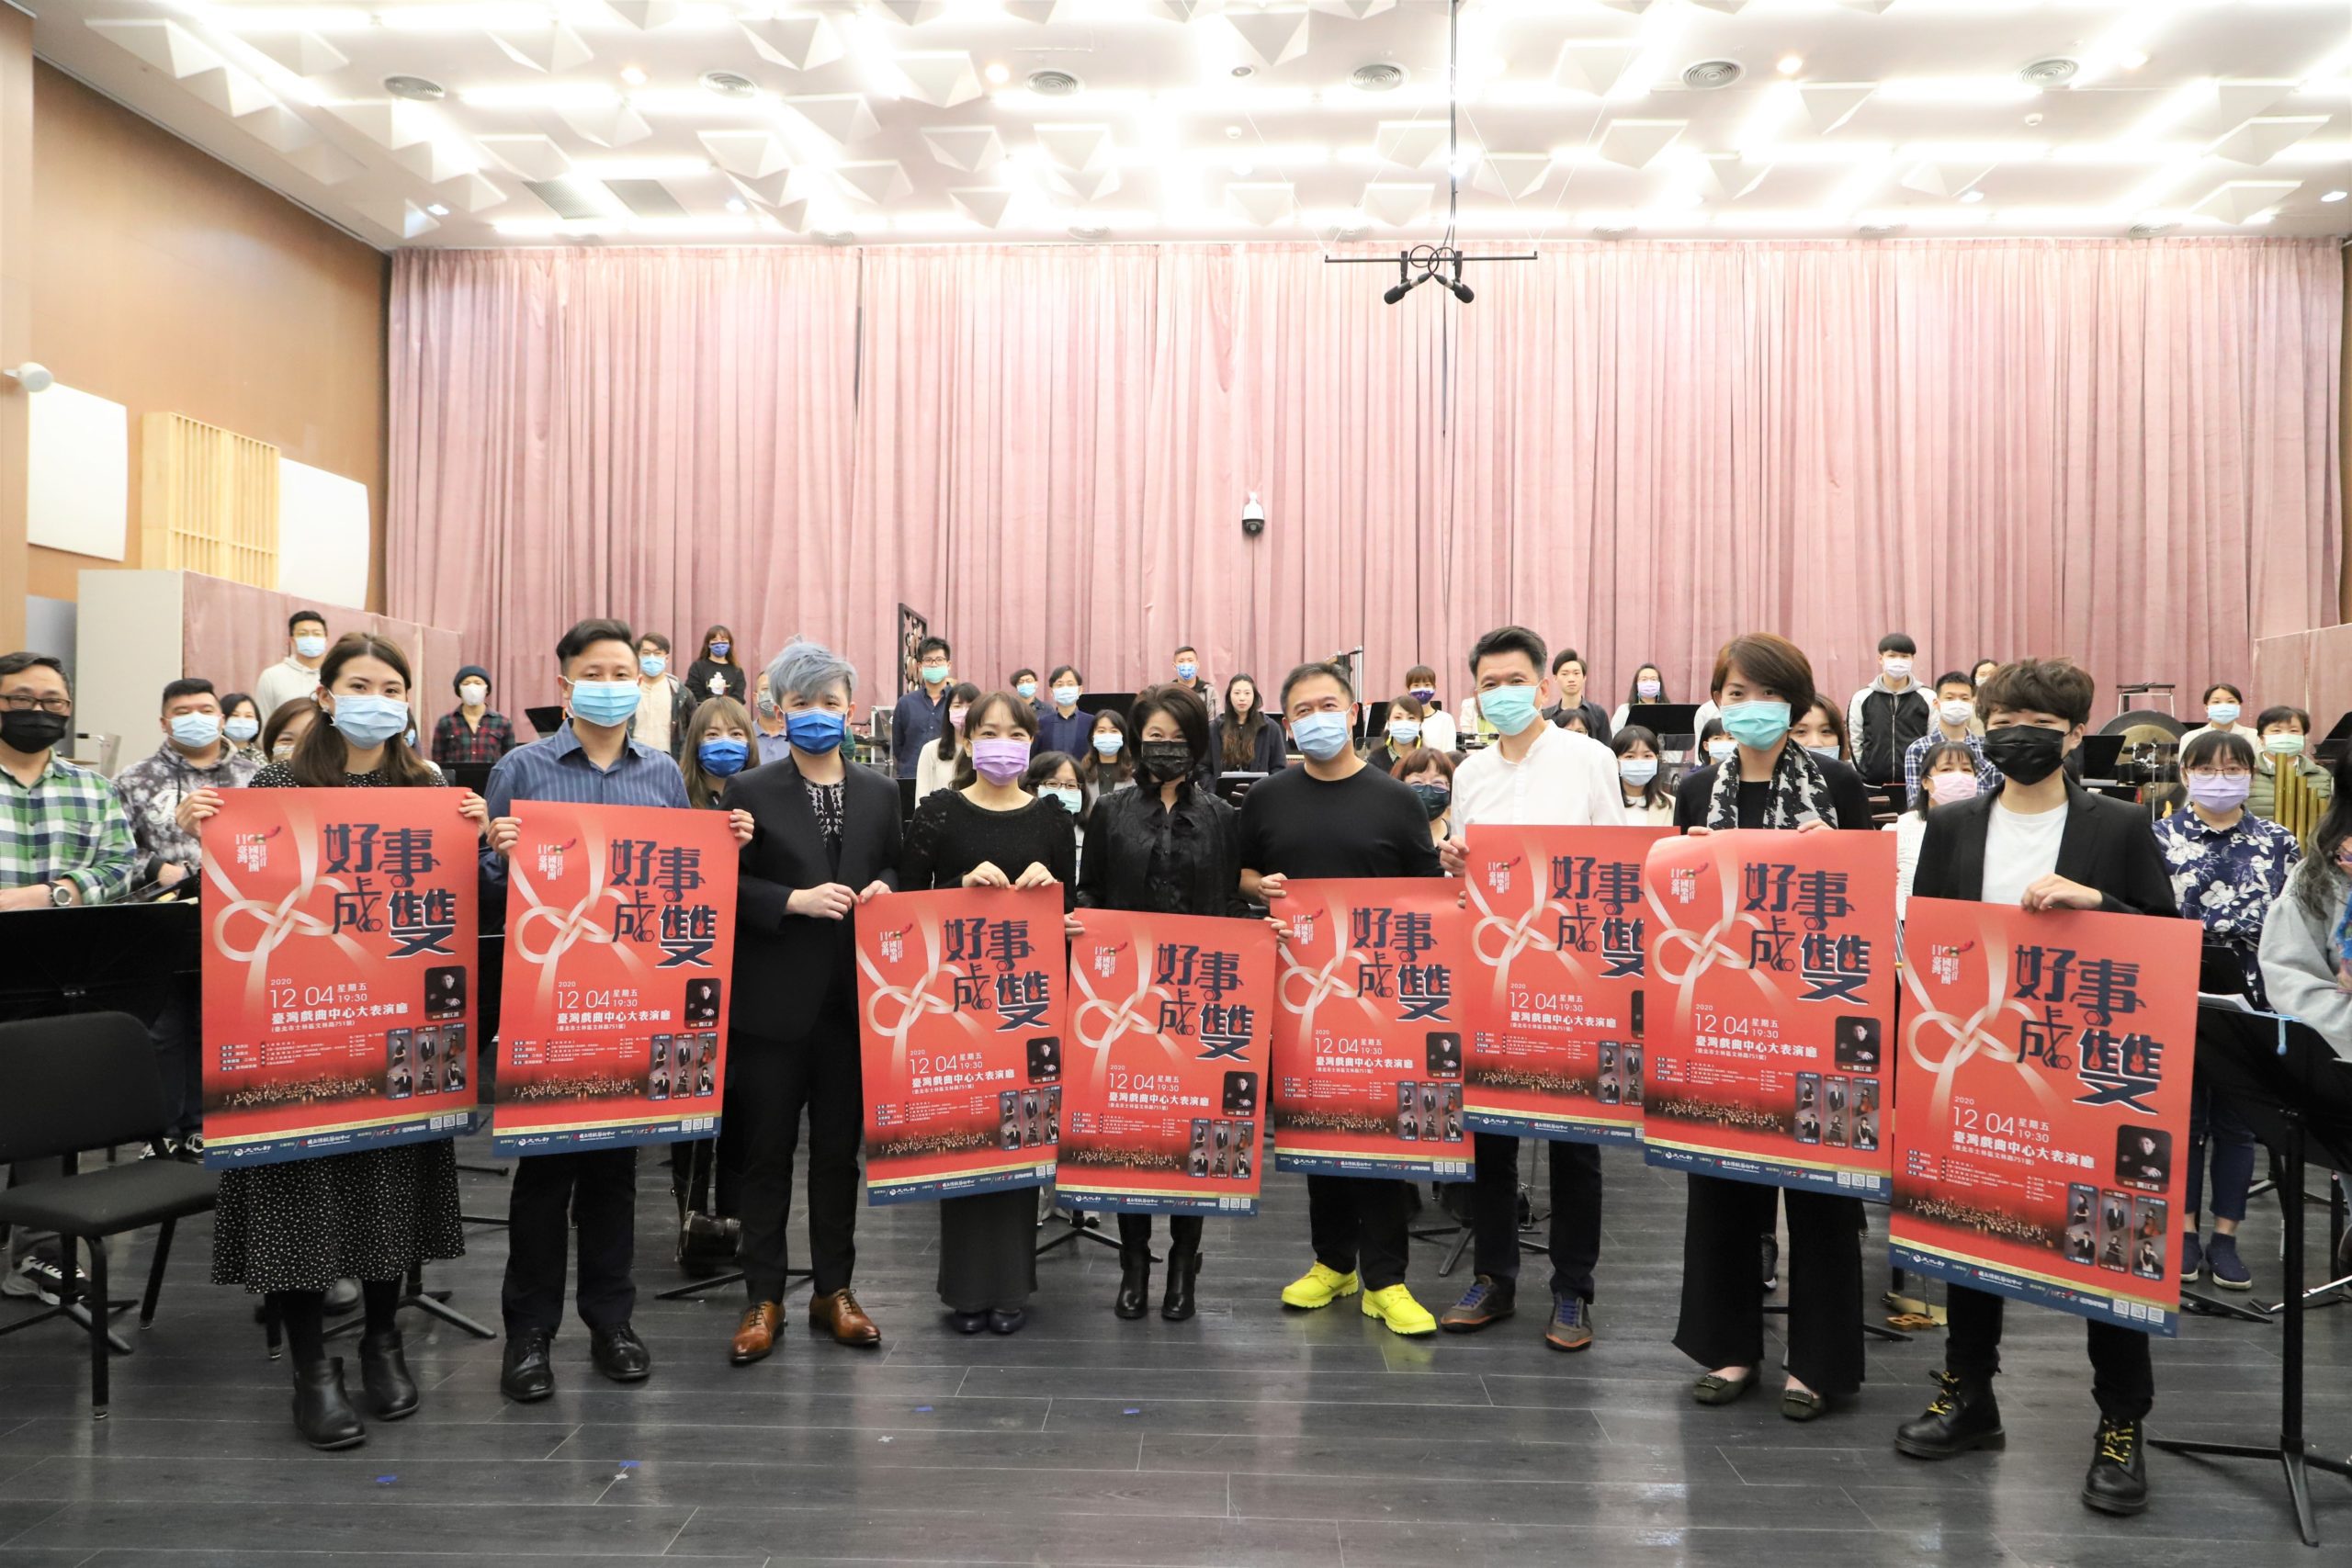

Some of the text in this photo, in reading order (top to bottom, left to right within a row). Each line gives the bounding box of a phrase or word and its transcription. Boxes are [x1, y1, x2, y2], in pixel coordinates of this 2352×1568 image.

[324, 822, 439, 890] 好事
[610, 839, 705, 903] 好事
[1552, 855, 1644, 916] 好事
[1744, 863, 1854, 931] 好事
[332, 873, 457, 958] 成雙
[612, 888, 717, 968] 成雙
[1352, 908, 1437, 963] 好事
[944, 917, 1034, 975] 好事
[1748, 915, 1871, 1005] 成雙
[270, 977, 292, 986] 2020
[1156, 943, 1243, 1001] 好事
[336, 982, 368, 993] 星期五
[612, 988, 638, 998] 星期五
[953, 958, 1050, 1032] 成雙
[1357, 950, 1451, 1022] 成雙
[2014, 945, 2144, 1027] 好事
[269, 985, 334, 1009] 12 04
[338, 992, 368, 1003] 19:30
[557, 989, 610, 1009] 12 04
[613, 998, 638, 1007] 19:30
[1510, 991, 1557, 1010] 12 04
[1559, 1002, 1583, 1012] 19:30
[1695, 1003, 1713, 1011] 2020
[1157, 988, 1254, 1062] 成雙
[1694, 1012, 1748, 1036] 12 04
[1751, 1017, 1779, 1028] 星期五
[1752, 1028, 1779, 1039] 19:30
[910, 1048, 925, 1056] 2020
[1314, 1037, 1359, 1055] 12 04
[1361, 1046, 1383, 1055] 19:30
[909, 1055, 957, 1075] 12 04
[958, 1051, 982, 1061] 星期五
[960, 1060, 983, 1069] 19:30
[2017, 1006, 2163, 1114] 成雙
[1109, 1072, 1155, 1090] 12 04
[1157, 1083, 1180, 1092] 19:30
[1954, 1095, 1974, 1105] 2020
[1952, 1105, 2015, 1136] 12 04
[2018, 1117, 2050, 1131] 星期五
[2018, 1128, 2050, 1144] 19:30
